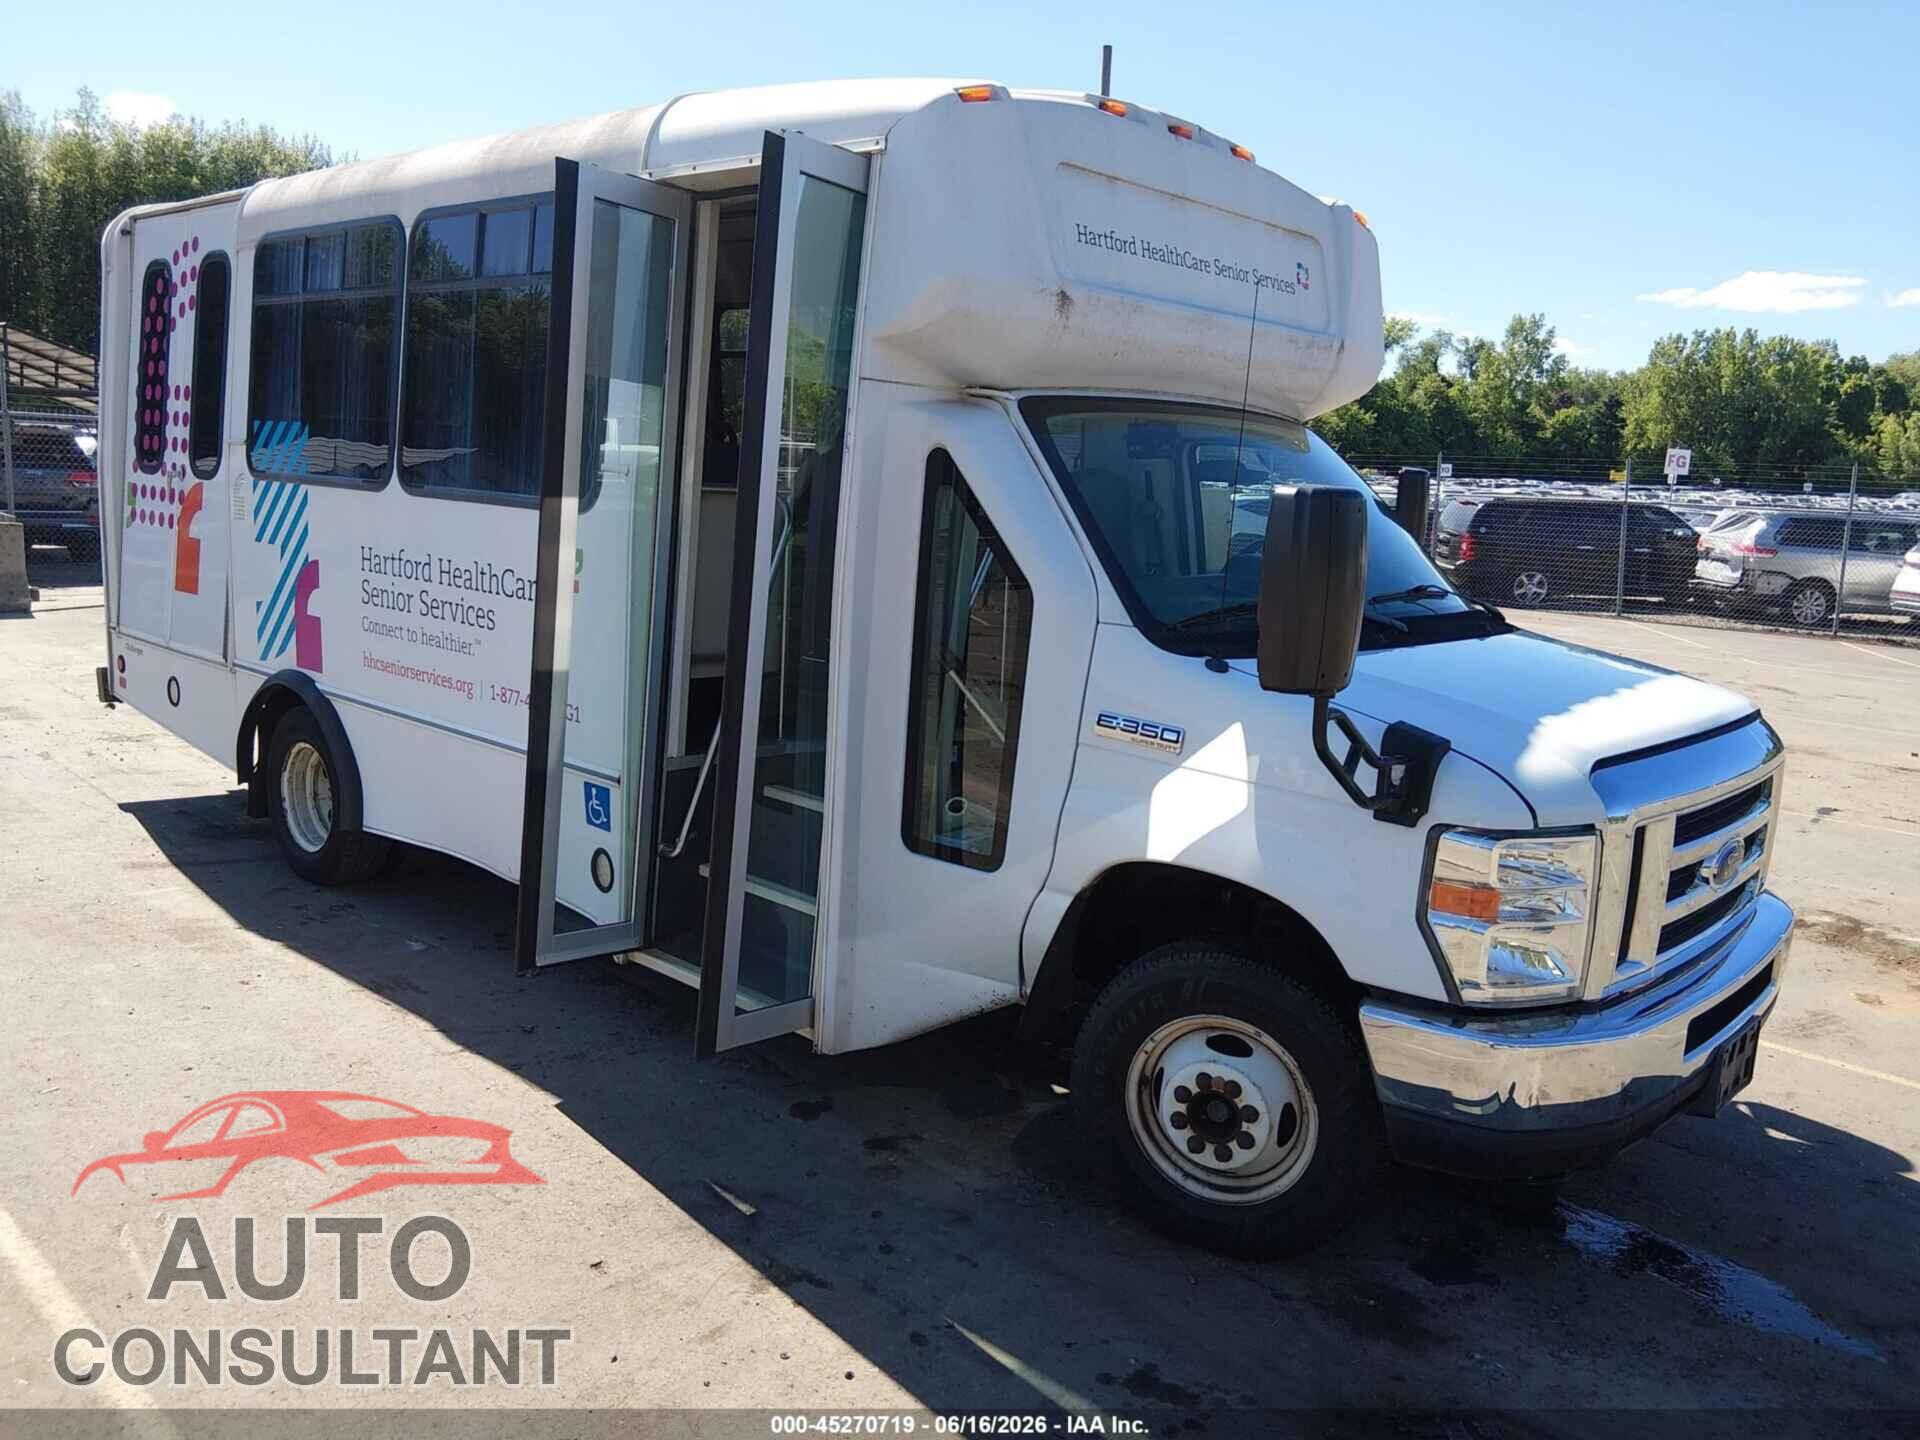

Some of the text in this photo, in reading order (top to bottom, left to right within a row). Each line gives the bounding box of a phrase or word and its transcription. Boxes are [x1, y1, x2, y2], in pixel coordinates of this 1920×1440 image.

[1075, 223, 1296, 295] Hartford HealthCare Senior Services
[1668, 454, 1687, 468] FG
[361, 546, 537, 601] Hartford HealthCar
[361, 579, 496, 631] Senior Services
[361, 616, 404, 641] Connect
[406, 626, 418, 643] to
[363, 651, 474, 700] hhcseniorservices.org
